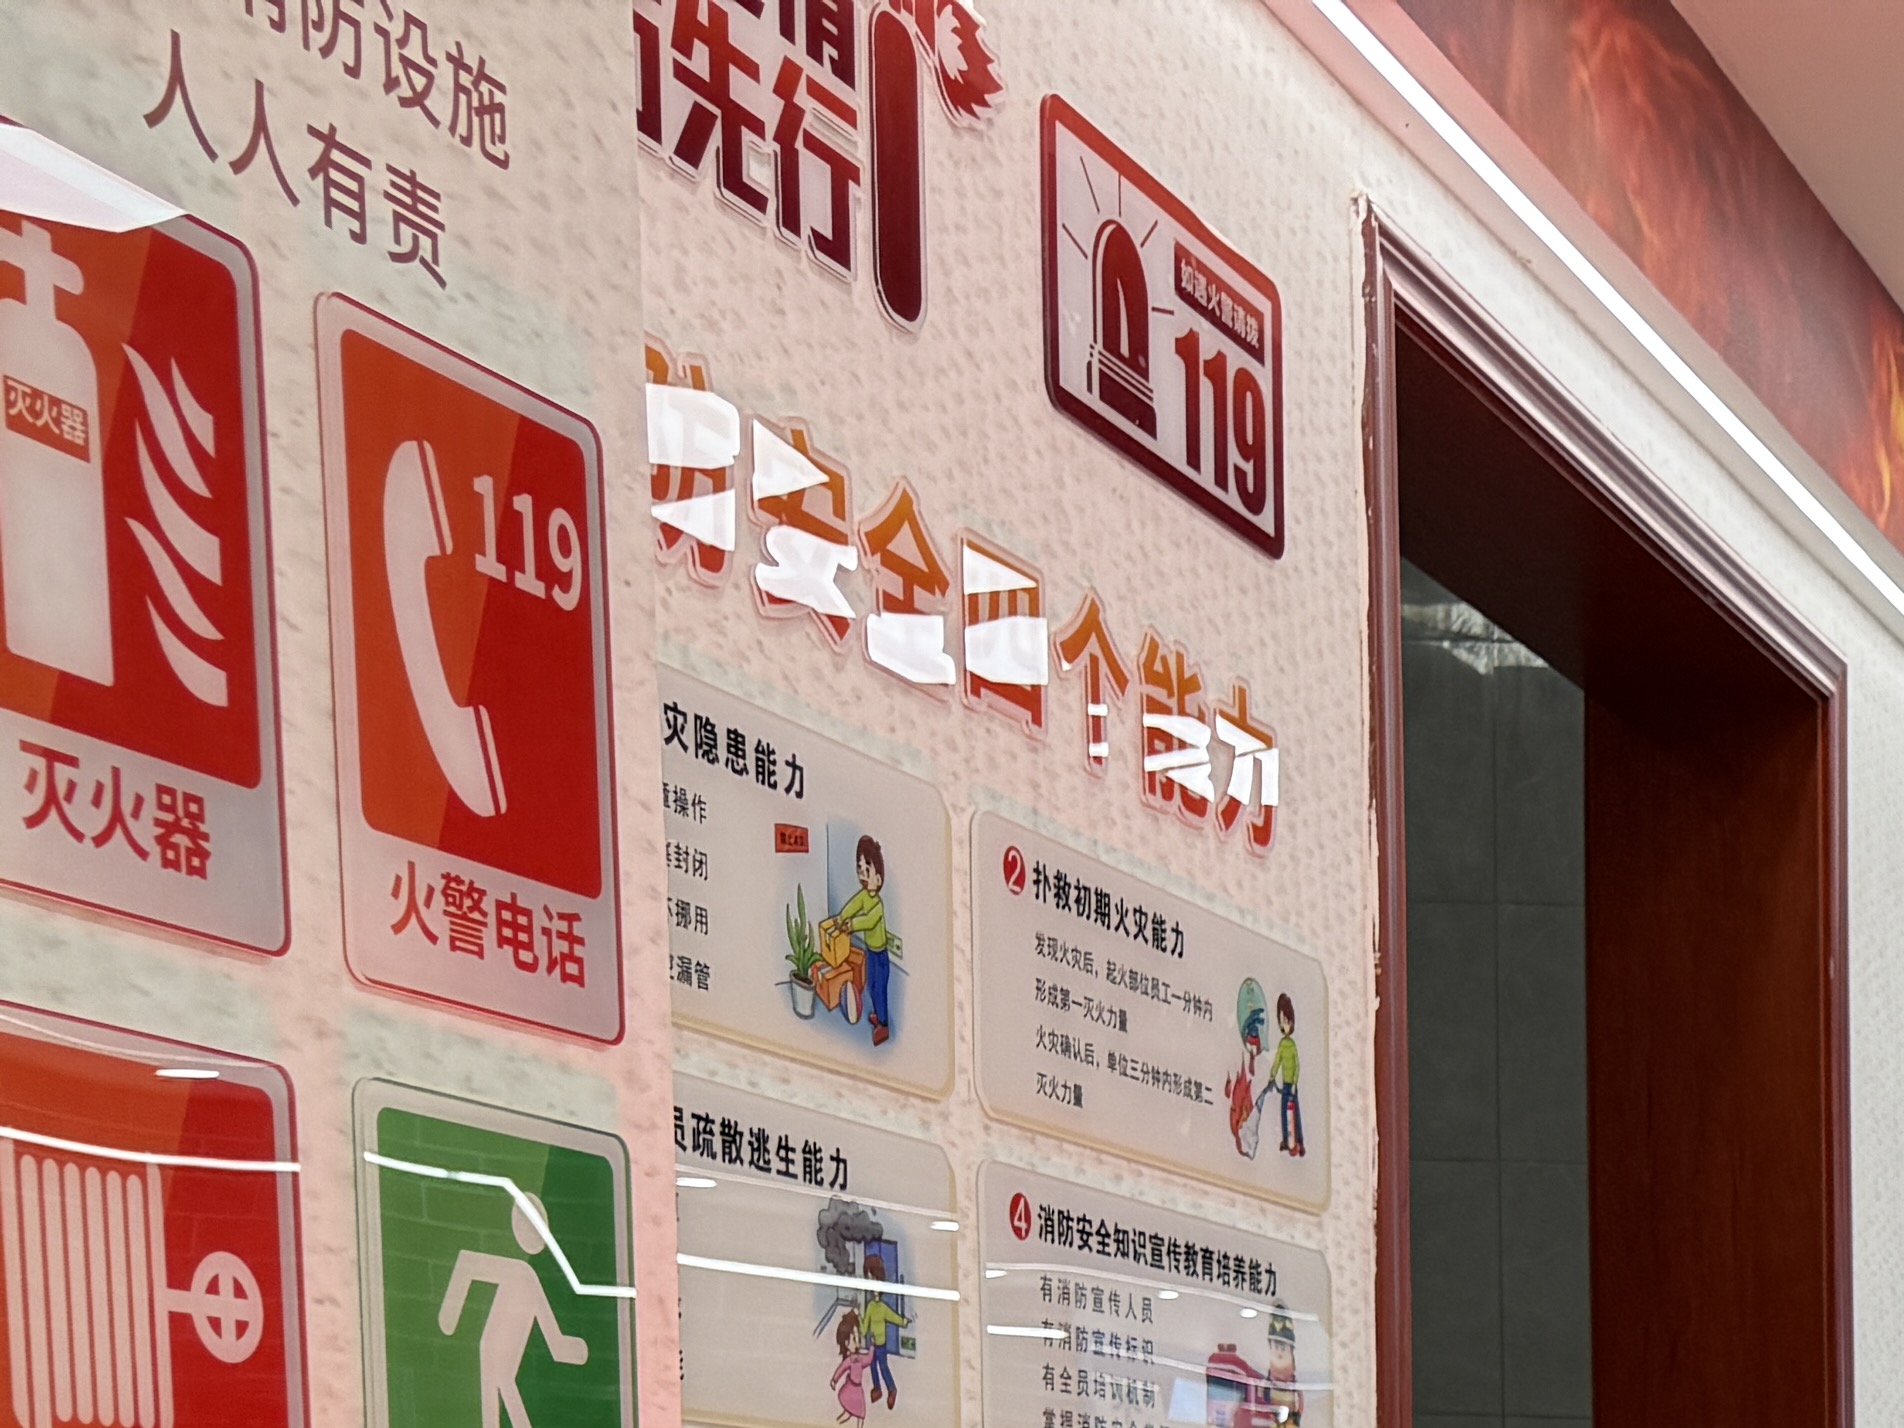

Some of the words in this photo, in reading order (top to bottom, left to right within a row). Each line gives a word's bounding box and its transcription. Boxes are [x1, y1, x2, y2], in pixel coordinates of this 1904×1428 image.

[246, 0, 512, 170] 防设施
[143, 29, 447, 290] 人人有责
[4, 382, 88, 445] 灭火器
[1174, 327, 1266, 517] 119
[473, 474, 583, 610] 119
[662, 700, 805, 800] 灾隐患能力
[19, 738, 212, 881] 灭火器
[1007, 849, 1023, 894] 2
[1033, 860, 1186, 959] 扑救初期火灾能力
[389, 860, 587, 989] 火警电话
[1034, 977, 1129, 1034] 形成第一灭火力量
[1036, 1071, 1084, 1109] 灭火力量
[1013, 1196, 1028, 1238] 4
[1037, 1204, 1279, 1298] 消防安全知识宣传教育培养能力
[1040, 1274, 1154, 1325] 有消防宣传人员
